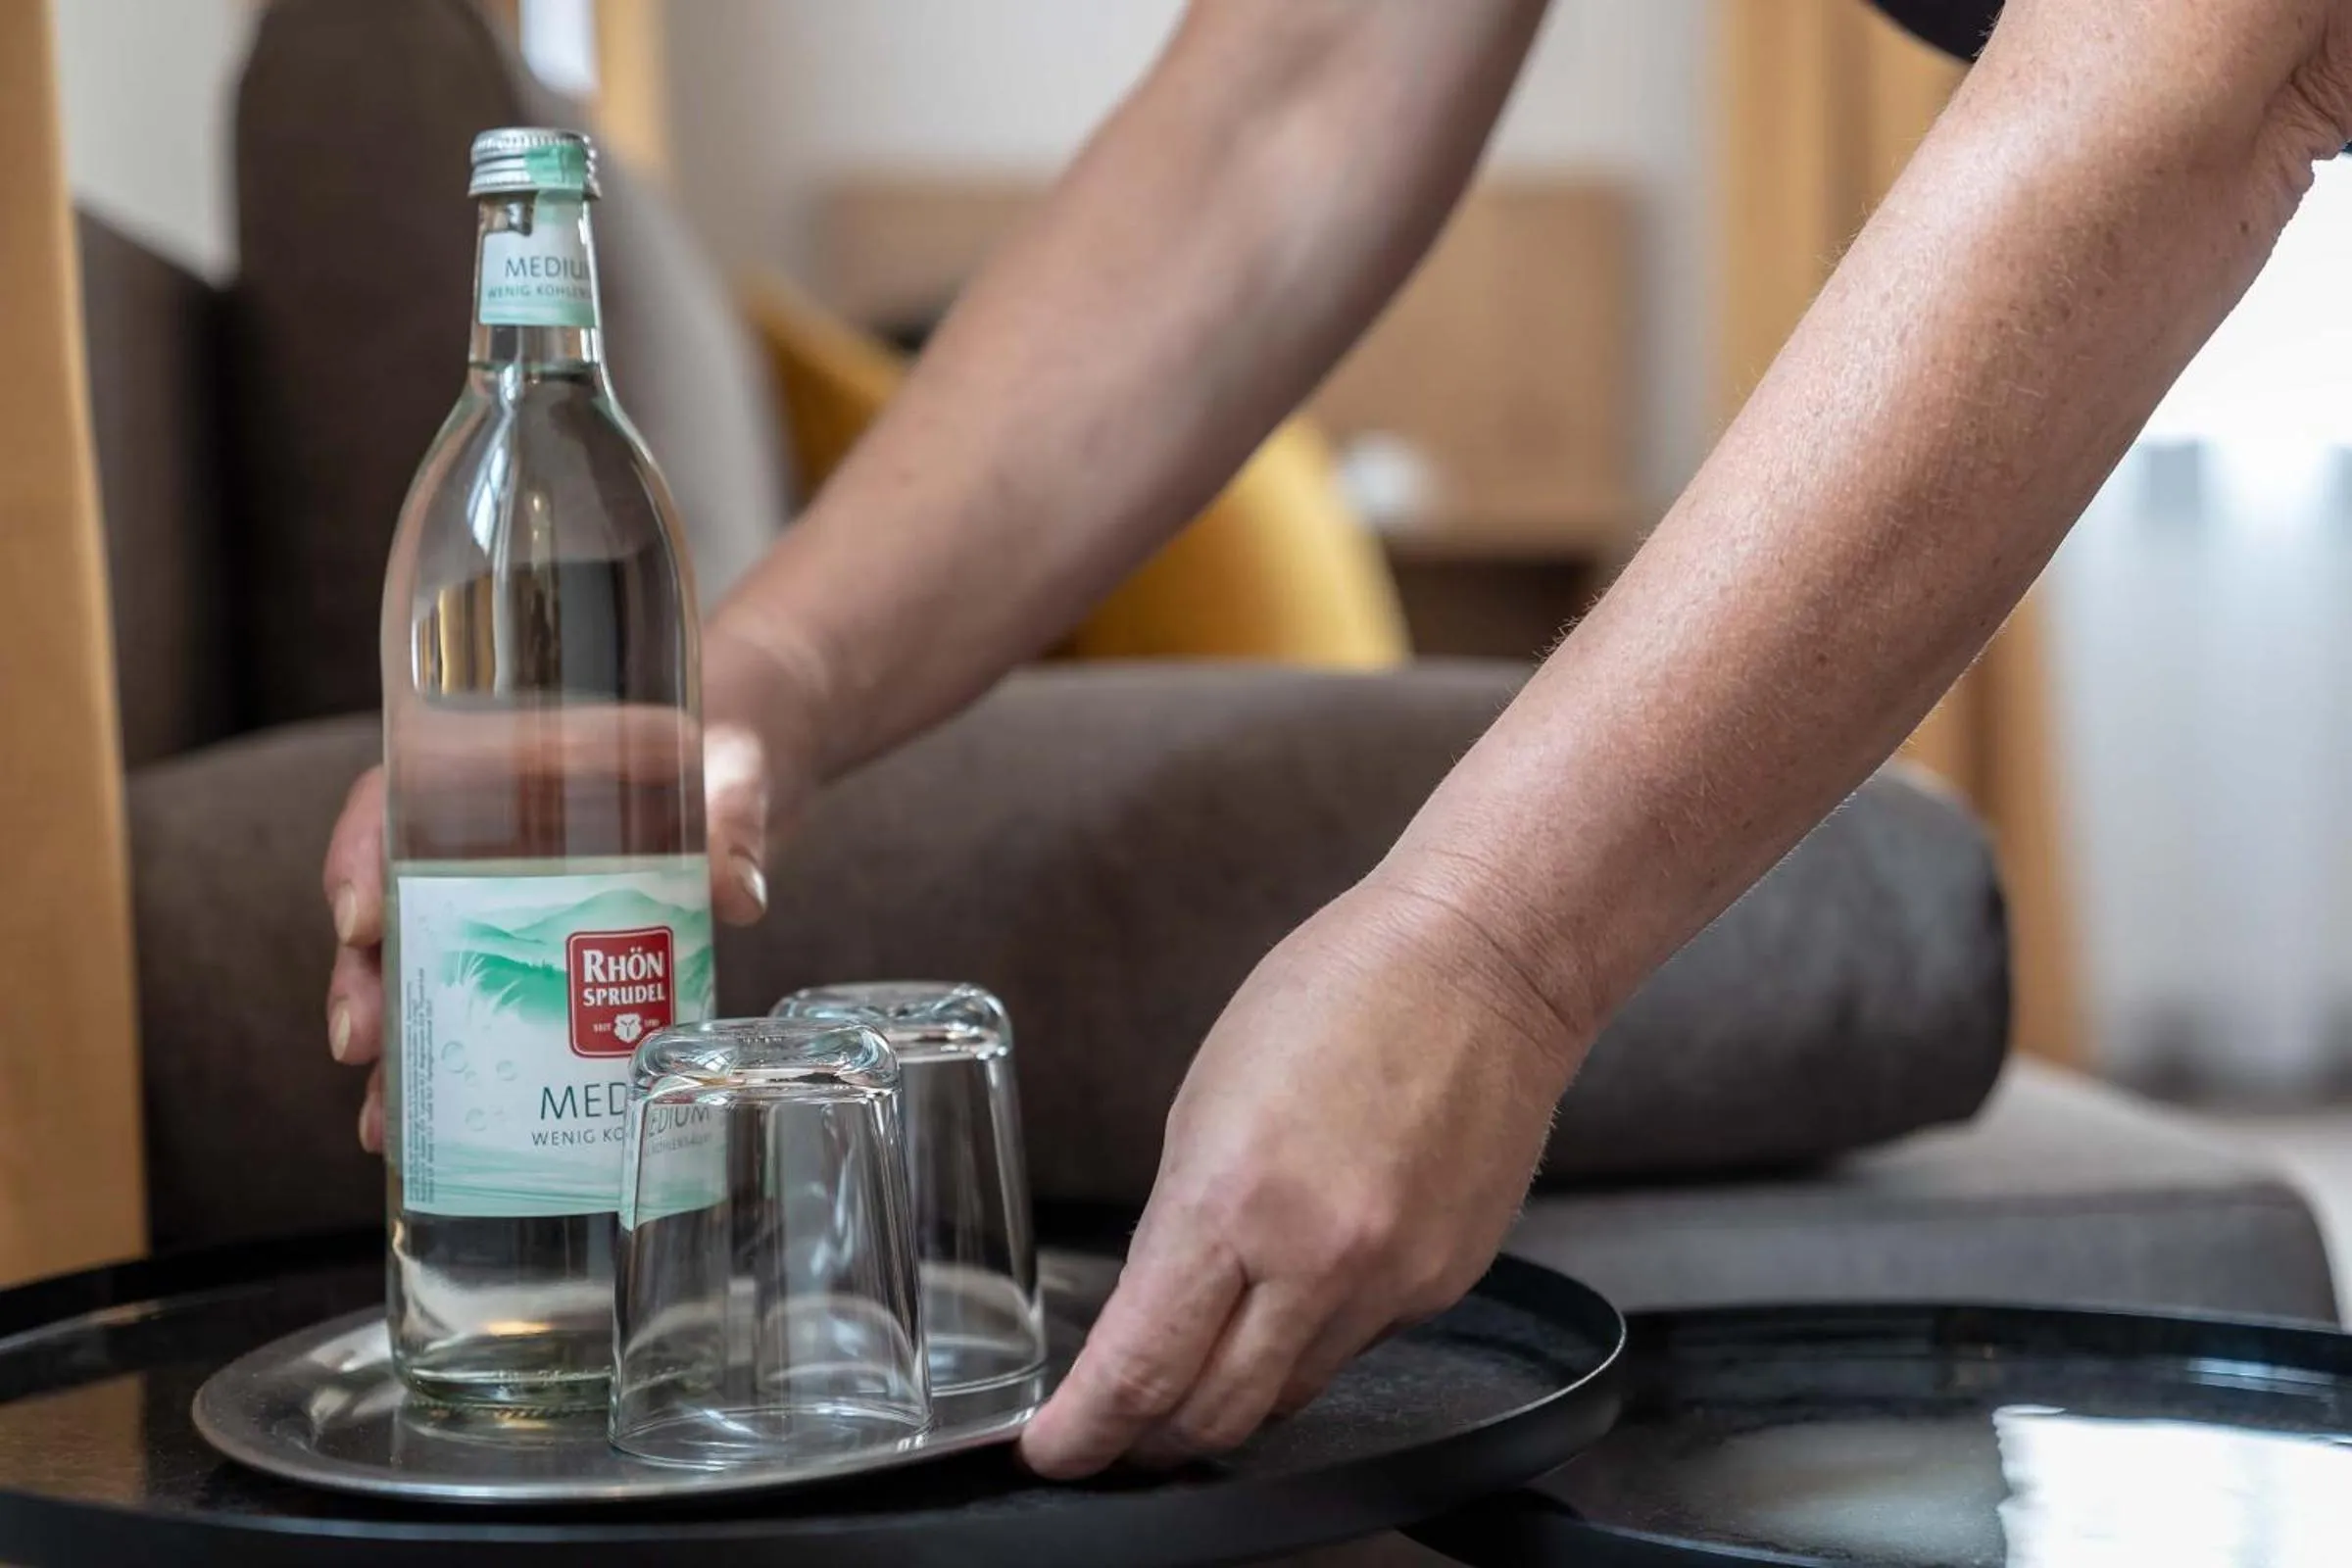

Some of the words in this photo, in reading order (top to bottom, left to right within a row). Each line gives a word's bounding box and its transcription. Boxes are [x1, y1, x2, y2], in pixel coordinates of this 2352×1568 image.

[582, 946, 664, 983] RHÖN
[582, 983, 665, 1007] SPRUDEL
[531, 1129, 596, 1148] WENIG
